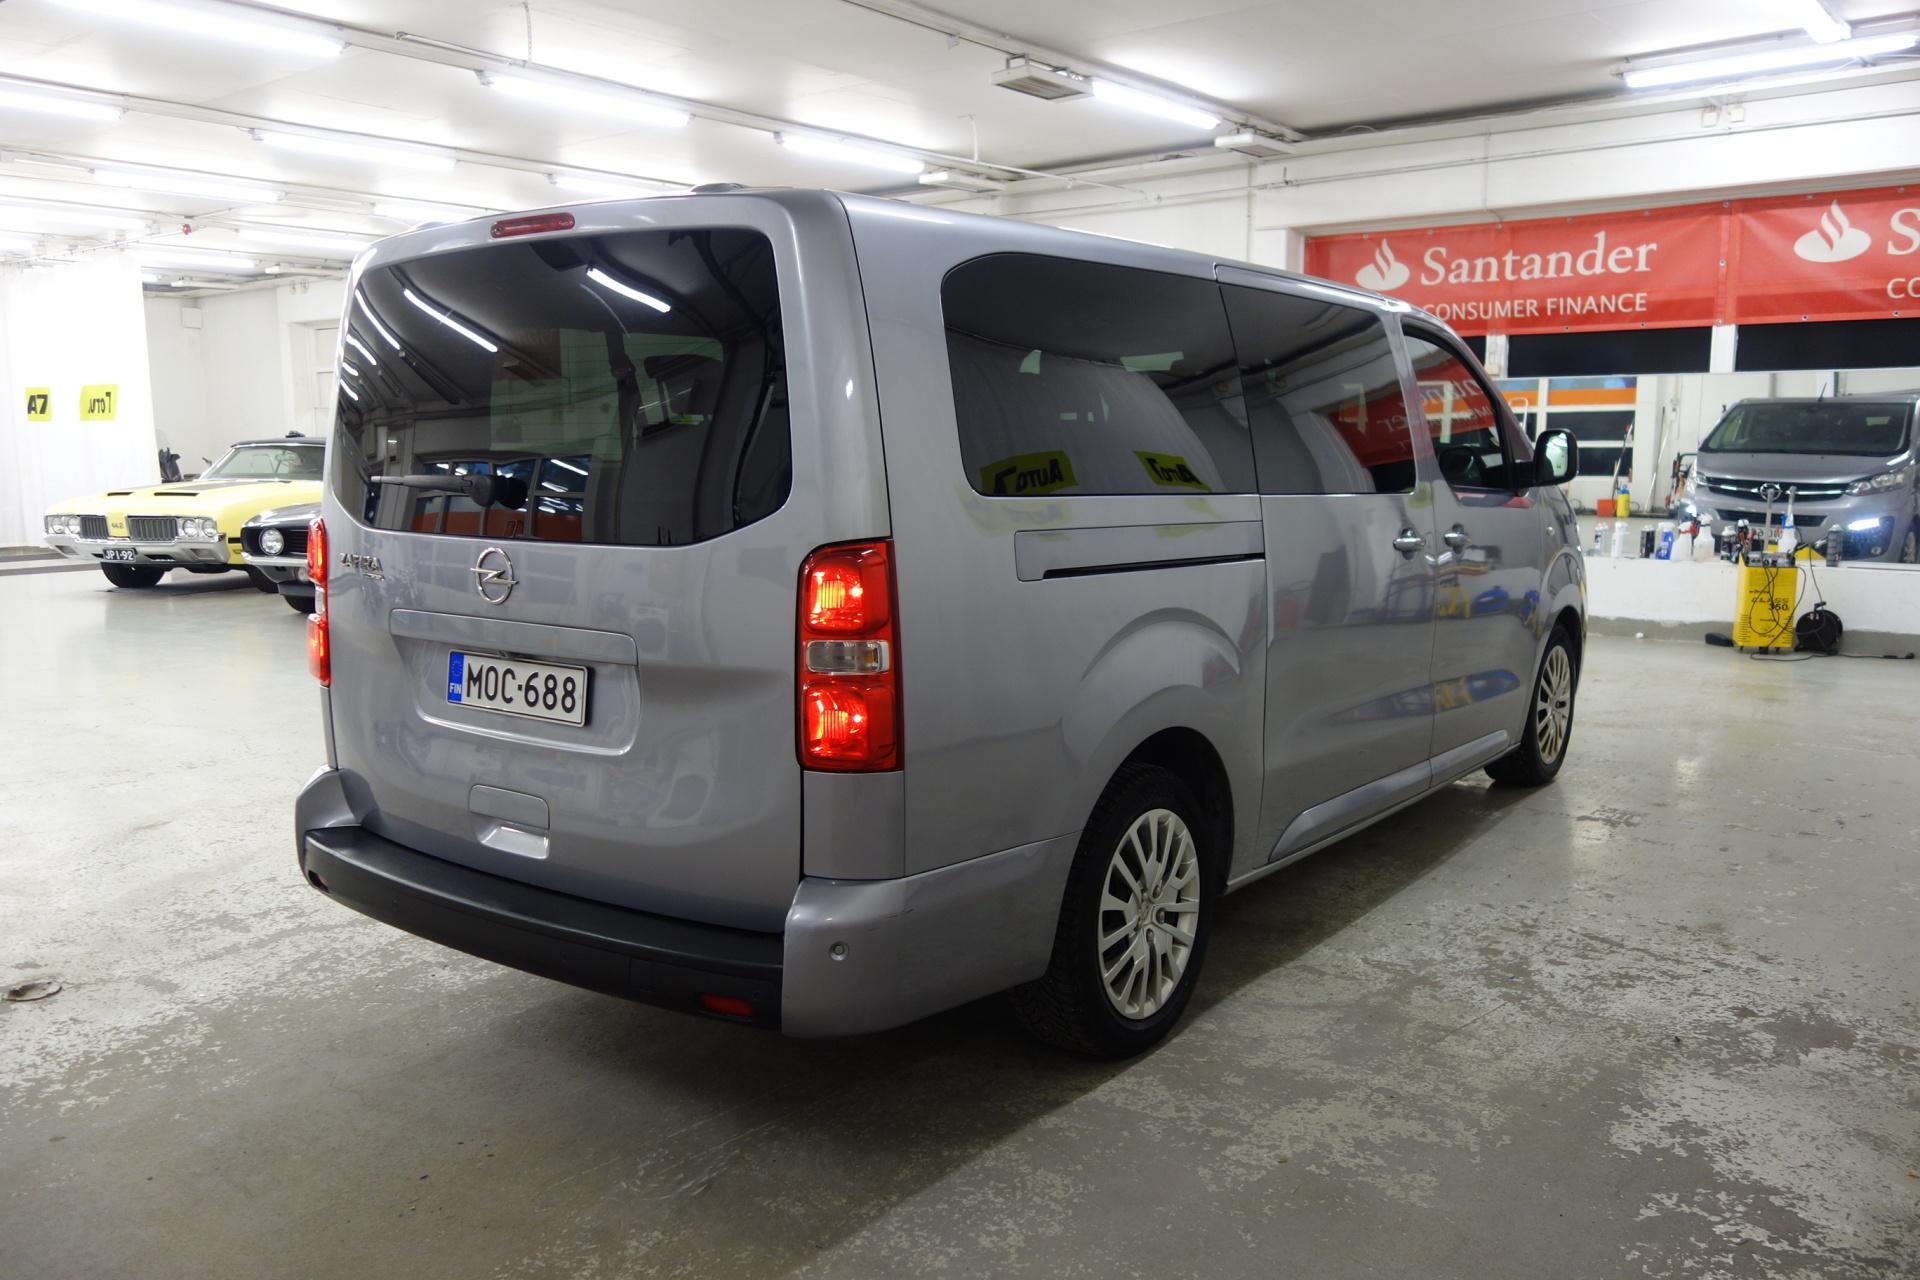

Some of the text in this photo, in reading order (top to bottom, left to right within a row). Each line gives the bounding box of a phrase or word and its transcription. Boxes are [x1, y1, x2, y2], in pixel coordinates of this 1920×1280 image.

[1420, 231, 1657, 286] Santander
[1546, 293, 1648, 316] FINANCE
[449, 682, 462, 695] FIN
[466, 662, 576, 713] MOC-688
